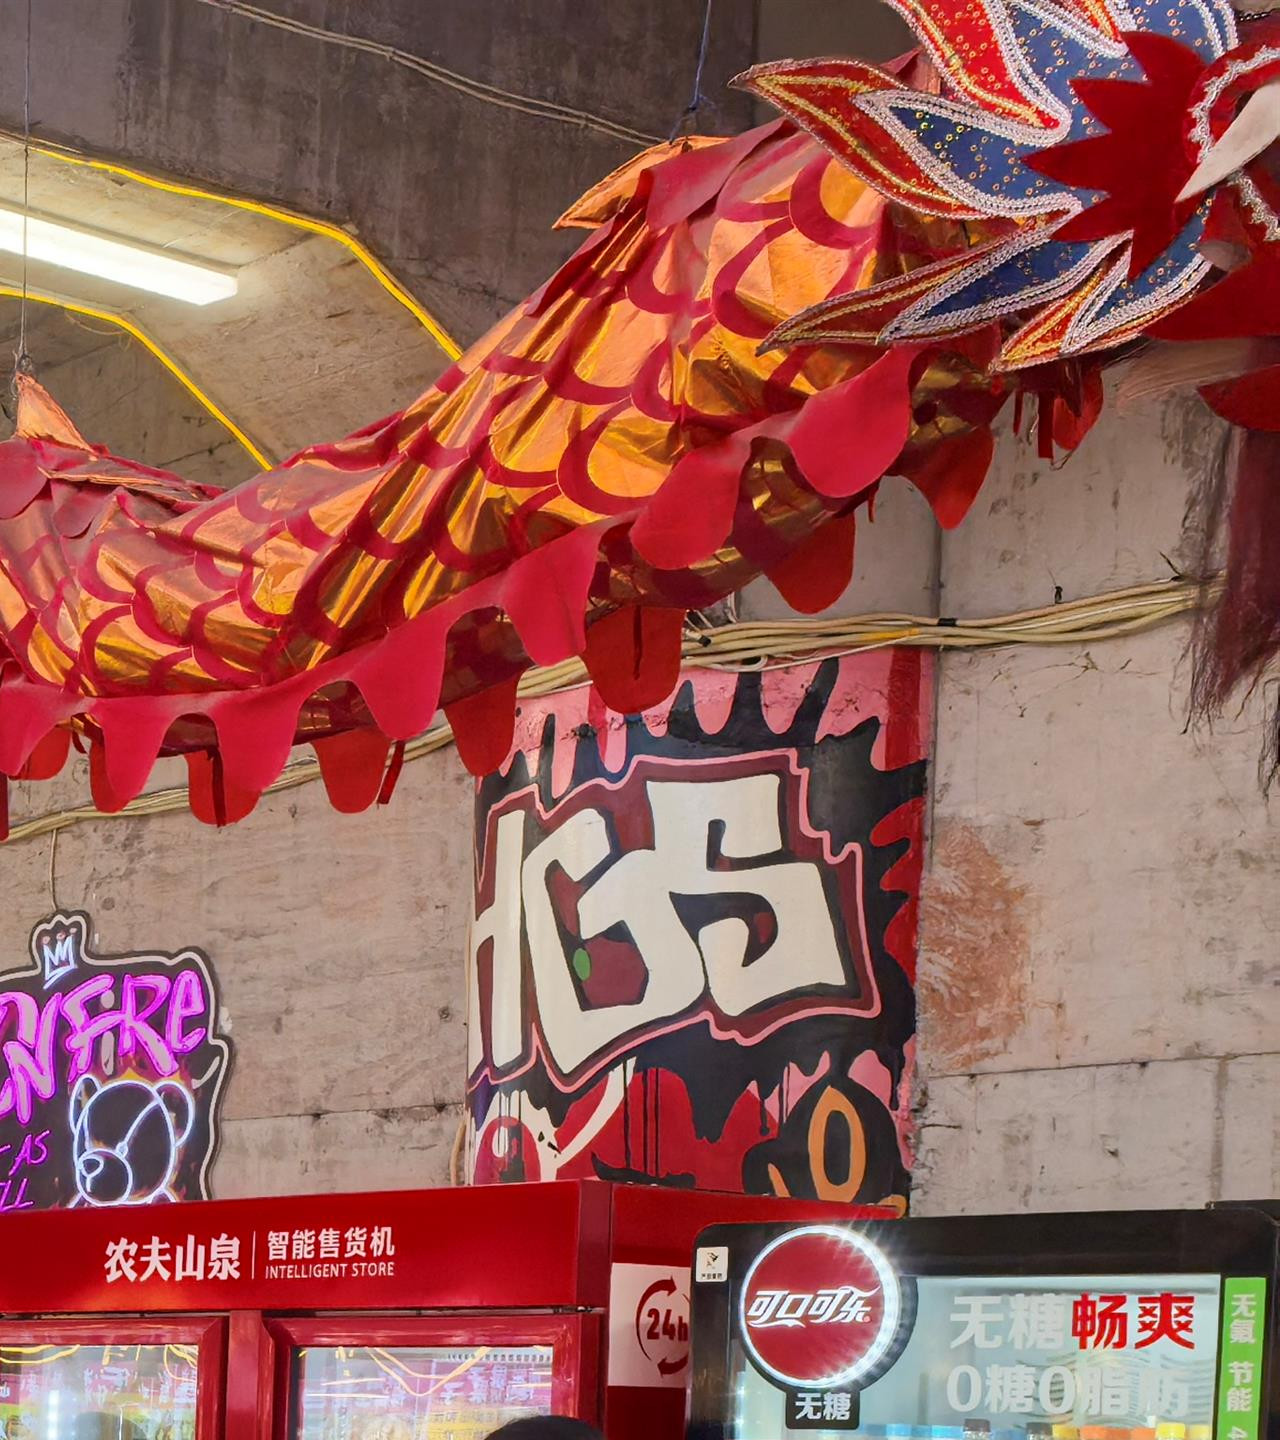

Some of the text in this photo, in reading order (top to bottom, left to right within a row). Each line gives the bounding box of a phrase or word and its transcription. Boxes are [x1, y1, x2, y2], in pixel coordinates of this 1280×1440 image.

[104, 1233, 241, 1284] 农夫山泉
[267, 1226, 396, 1261] 智能售货机
[265, 1261, 396, 1280] INTELLIGENT STORE
[646, 1307, 689, 1342] 24h
[747, 1284, 881, 1329] 可口可乐
[950, 1291, 1196, 1351] 无糖畅爽
[795, 1392, 852, 1421] 无糖
[1227, 1360, 1255, 1413] 节能
